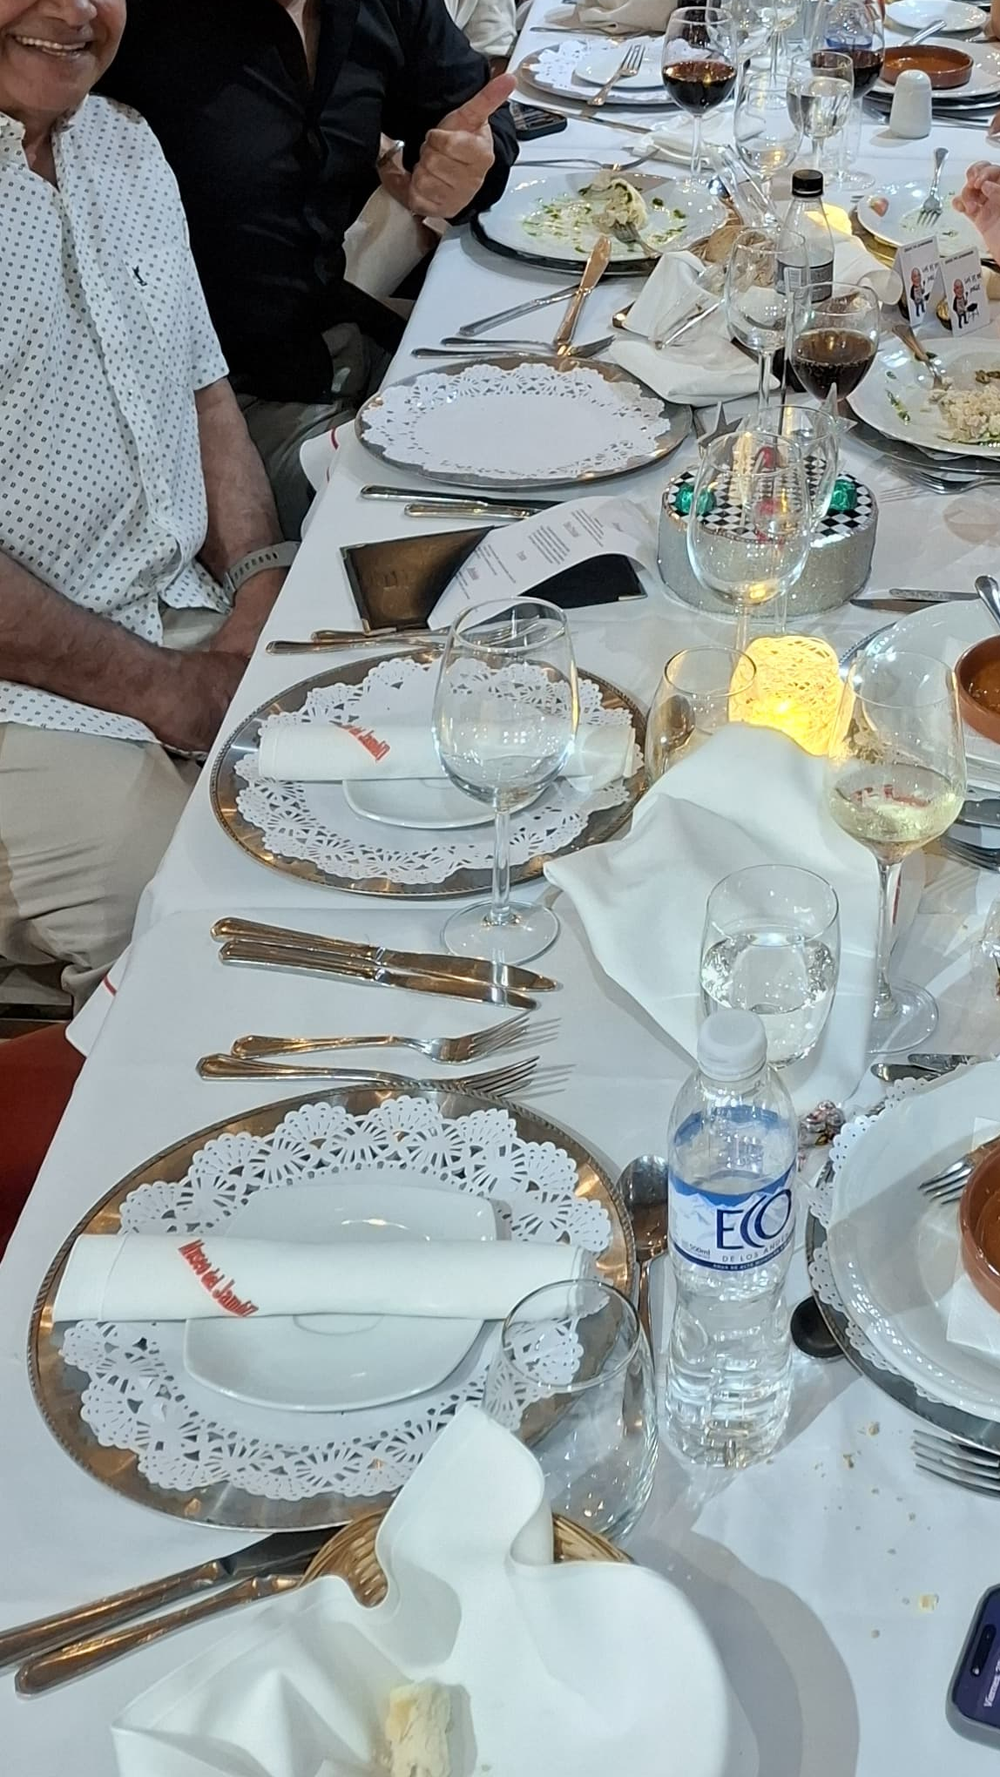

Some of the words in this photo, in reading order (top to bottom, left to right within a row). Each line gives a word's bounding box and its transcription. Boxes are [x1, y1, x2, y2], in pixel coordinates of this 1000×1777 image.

[716, 1188, 793, 1250] ECO
[178, 1238, 212, 1276] Museo
[721, 1254, 735, 1263] DE
[740, 1251, 759, 1263] LOS
